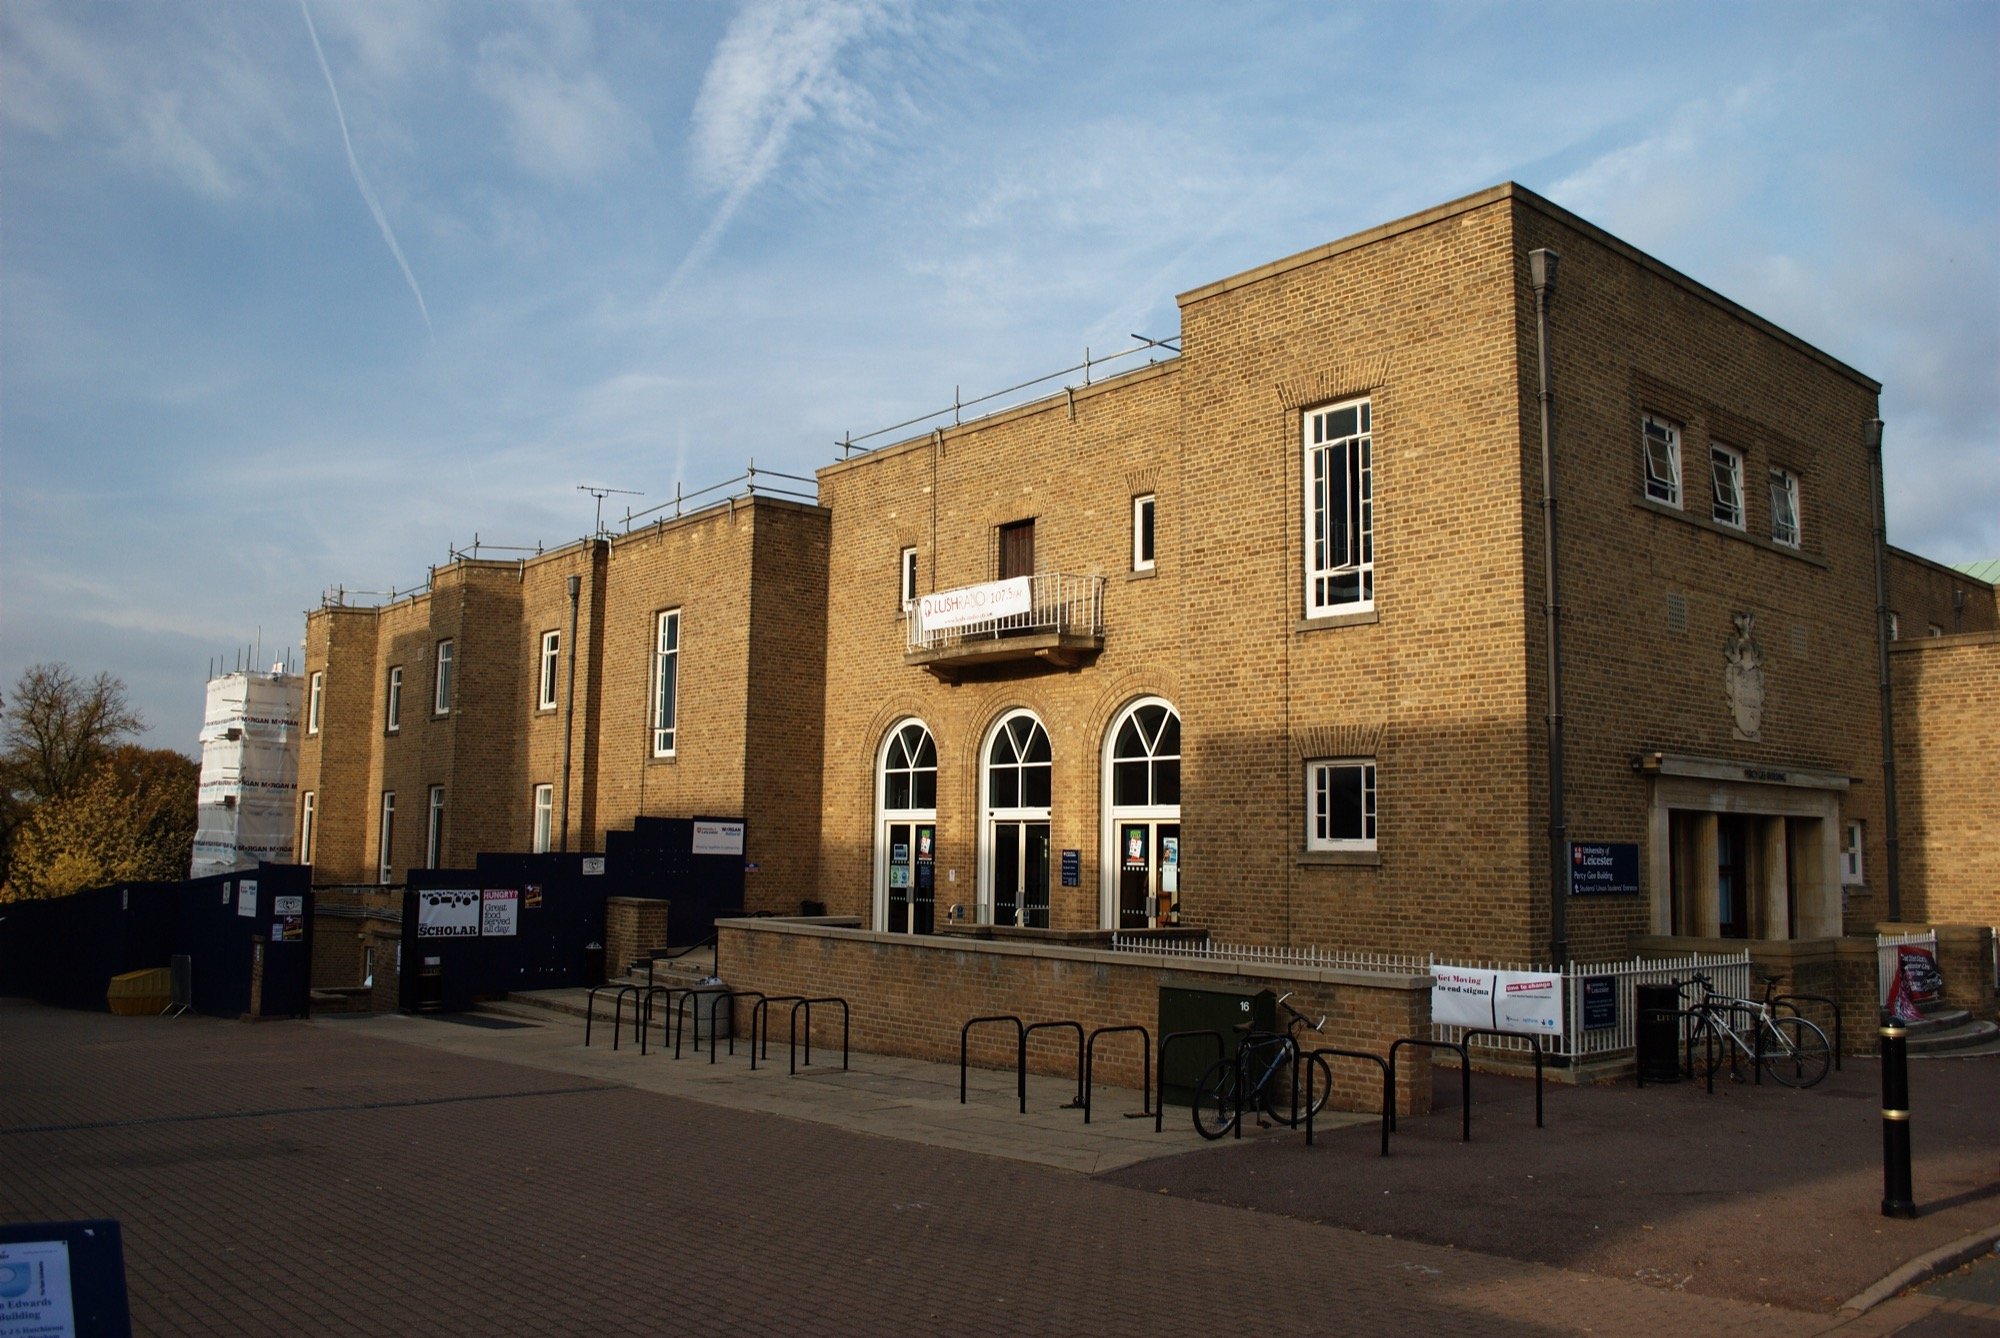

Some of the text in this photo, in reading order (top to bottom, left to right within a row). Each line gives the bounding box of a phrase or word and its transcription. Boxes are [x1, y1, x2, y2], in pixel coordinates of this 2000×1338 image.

[1583, 855, 1613, 866] Leicester
[484, 890, 518, 899] HUNGRY?
[485, 903, 508, 911] Great
[485, 911, 501, 919] food
[418, 926, 478, 936] SCHOLAR
[1437, 973, 1481, 985] Get Moving
[1447, 984, 1461, 993] end
[1463, 986, 1489, 996] stigma
[1240, 1001, 1250, 1012] 16
[8, 1299, 52, 1309] Edwards
[0, 1311, 41, 1321] Building
